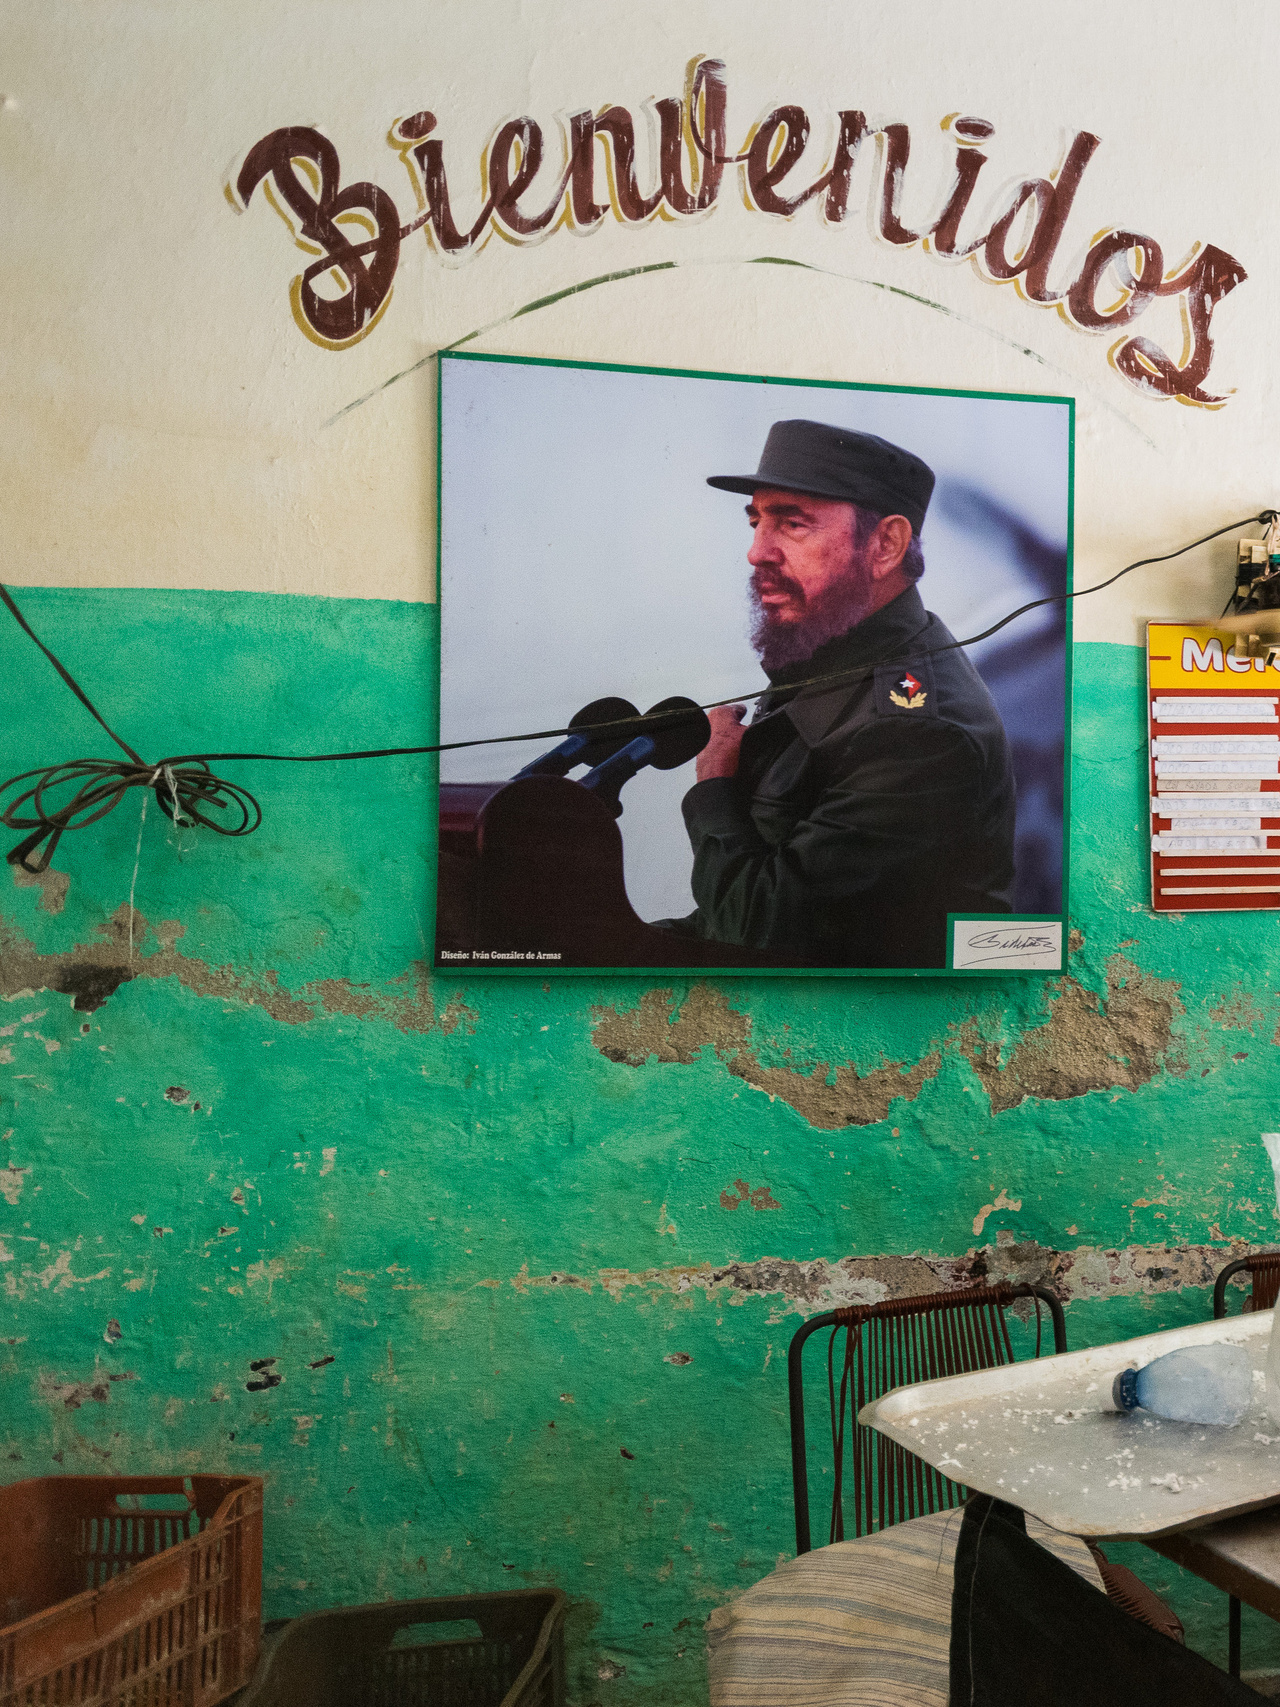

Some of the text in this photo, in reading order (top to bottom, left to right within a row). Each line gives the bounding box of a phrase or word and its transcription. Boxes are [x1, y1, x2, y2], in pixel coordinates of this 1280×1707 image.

[226, 54, 1249, 408] Bienvenidos
[441, 950, 562, 960] Diseño: Iván González de Armas
